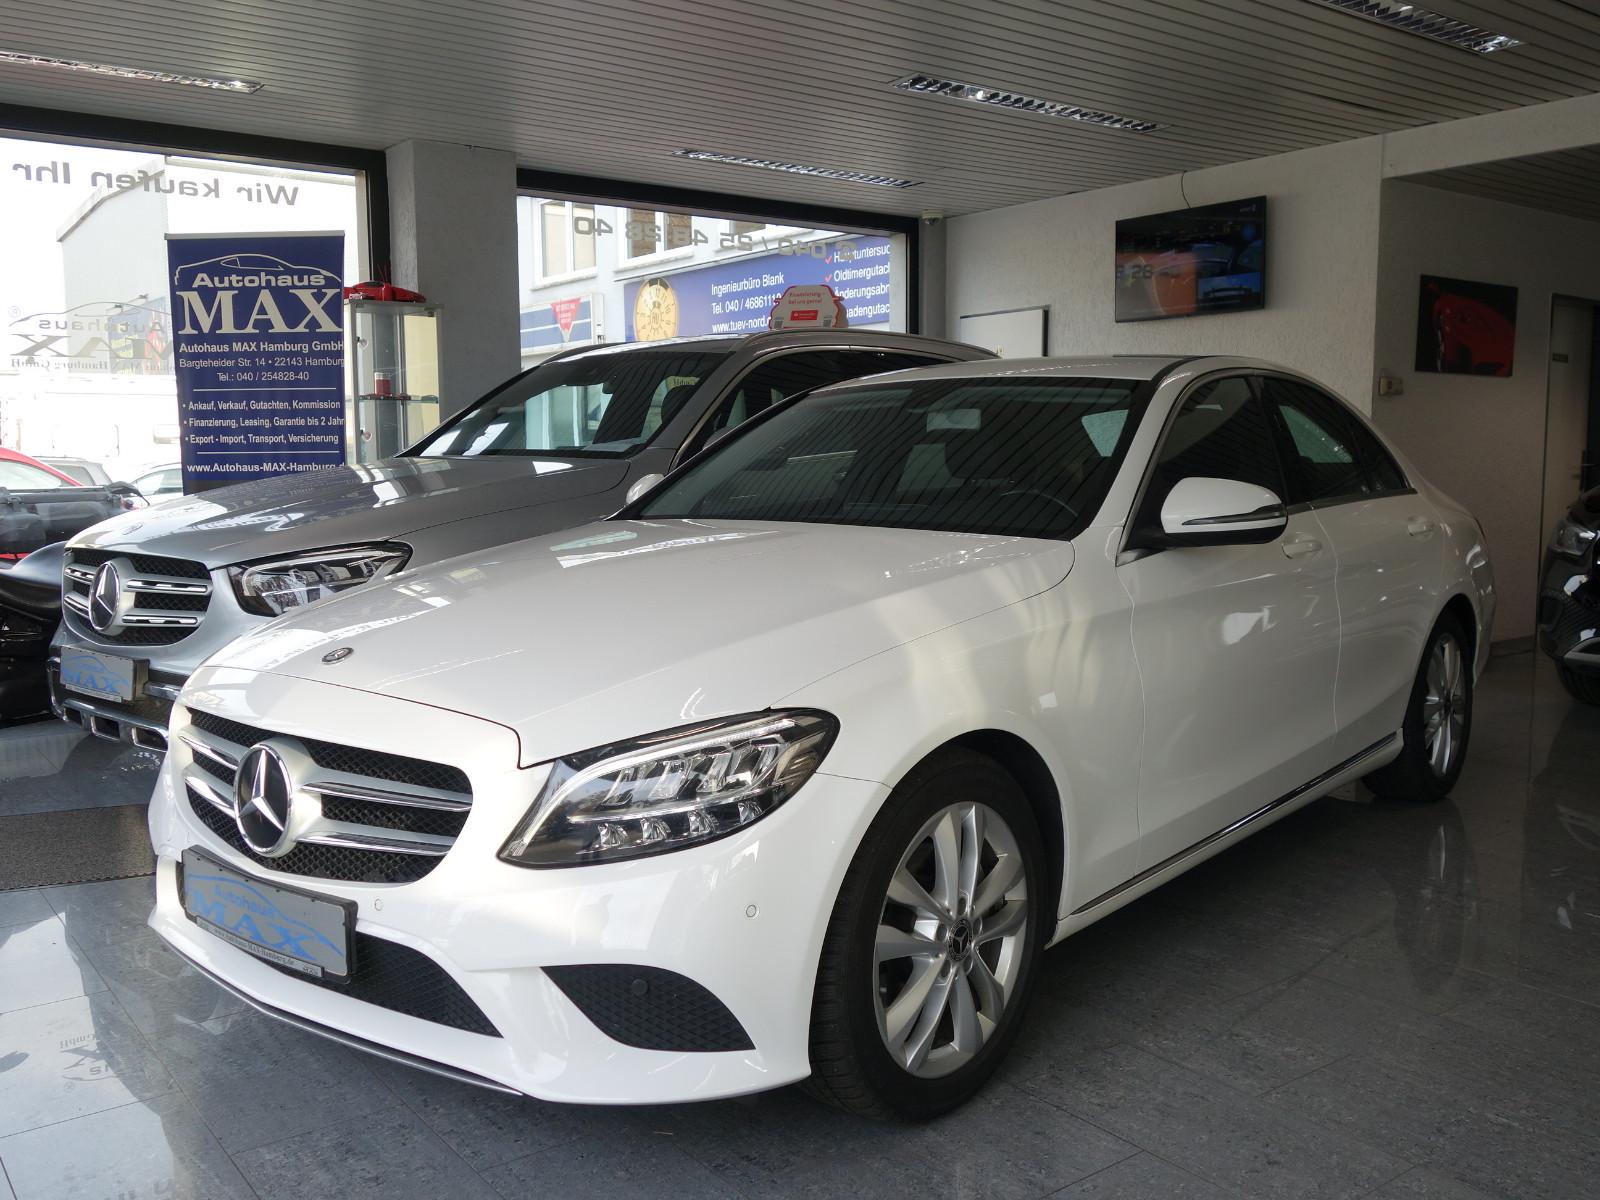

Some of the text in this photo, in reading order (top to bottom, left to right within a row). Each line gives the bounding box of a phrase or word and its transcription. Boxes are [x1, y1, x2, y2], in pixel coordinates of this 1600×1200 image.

[833, 244, 891, 264] Htuntersuc
[191, 271, 326, 288] Autohaus
[711, 271, 785, 298] Ingenieurbüro Blank
[175, 288, 344, 335] MAX
[711, 301, 724, 315] Tel.
[725, 299, 739, 313] 040
[179, 340, 344, 354] Autohaus MAX Hamburg GmbH
[179, 358, 236, 370] Bargteheider
[238, 358, 252, 367] Str.
[255, 358, 266, 367] 14
[274, 357, 303, 367] 22143
[217, 372, 234, 382] Tel.:
[236, 371, 253, 382] 040
[261, 371, 310, 382] 254828-40
[188, 399, 341, 411] Ankauf, Verkauf, Gutachten, Kommission
[189, 417, 239, 429] Finanzierung,
[240, 417, 272, 428] Leasing,
[273, 416, 306, 427] Garantie
[307, 416, 319, 426] bis
[320, 417, 326, 426] 2
[190, 434, 214, 446] Export
[220, 434, 247, 445] Import,
[247, 433, 287, 445] Transport,
[287, 433, 339, 444] Versicherung
[186, 461, 346, 473] www.Autohaus-MAX-Hambur
[213, 884, 277, 918] Autohaus
[190, 889, 318, 961] MAX
